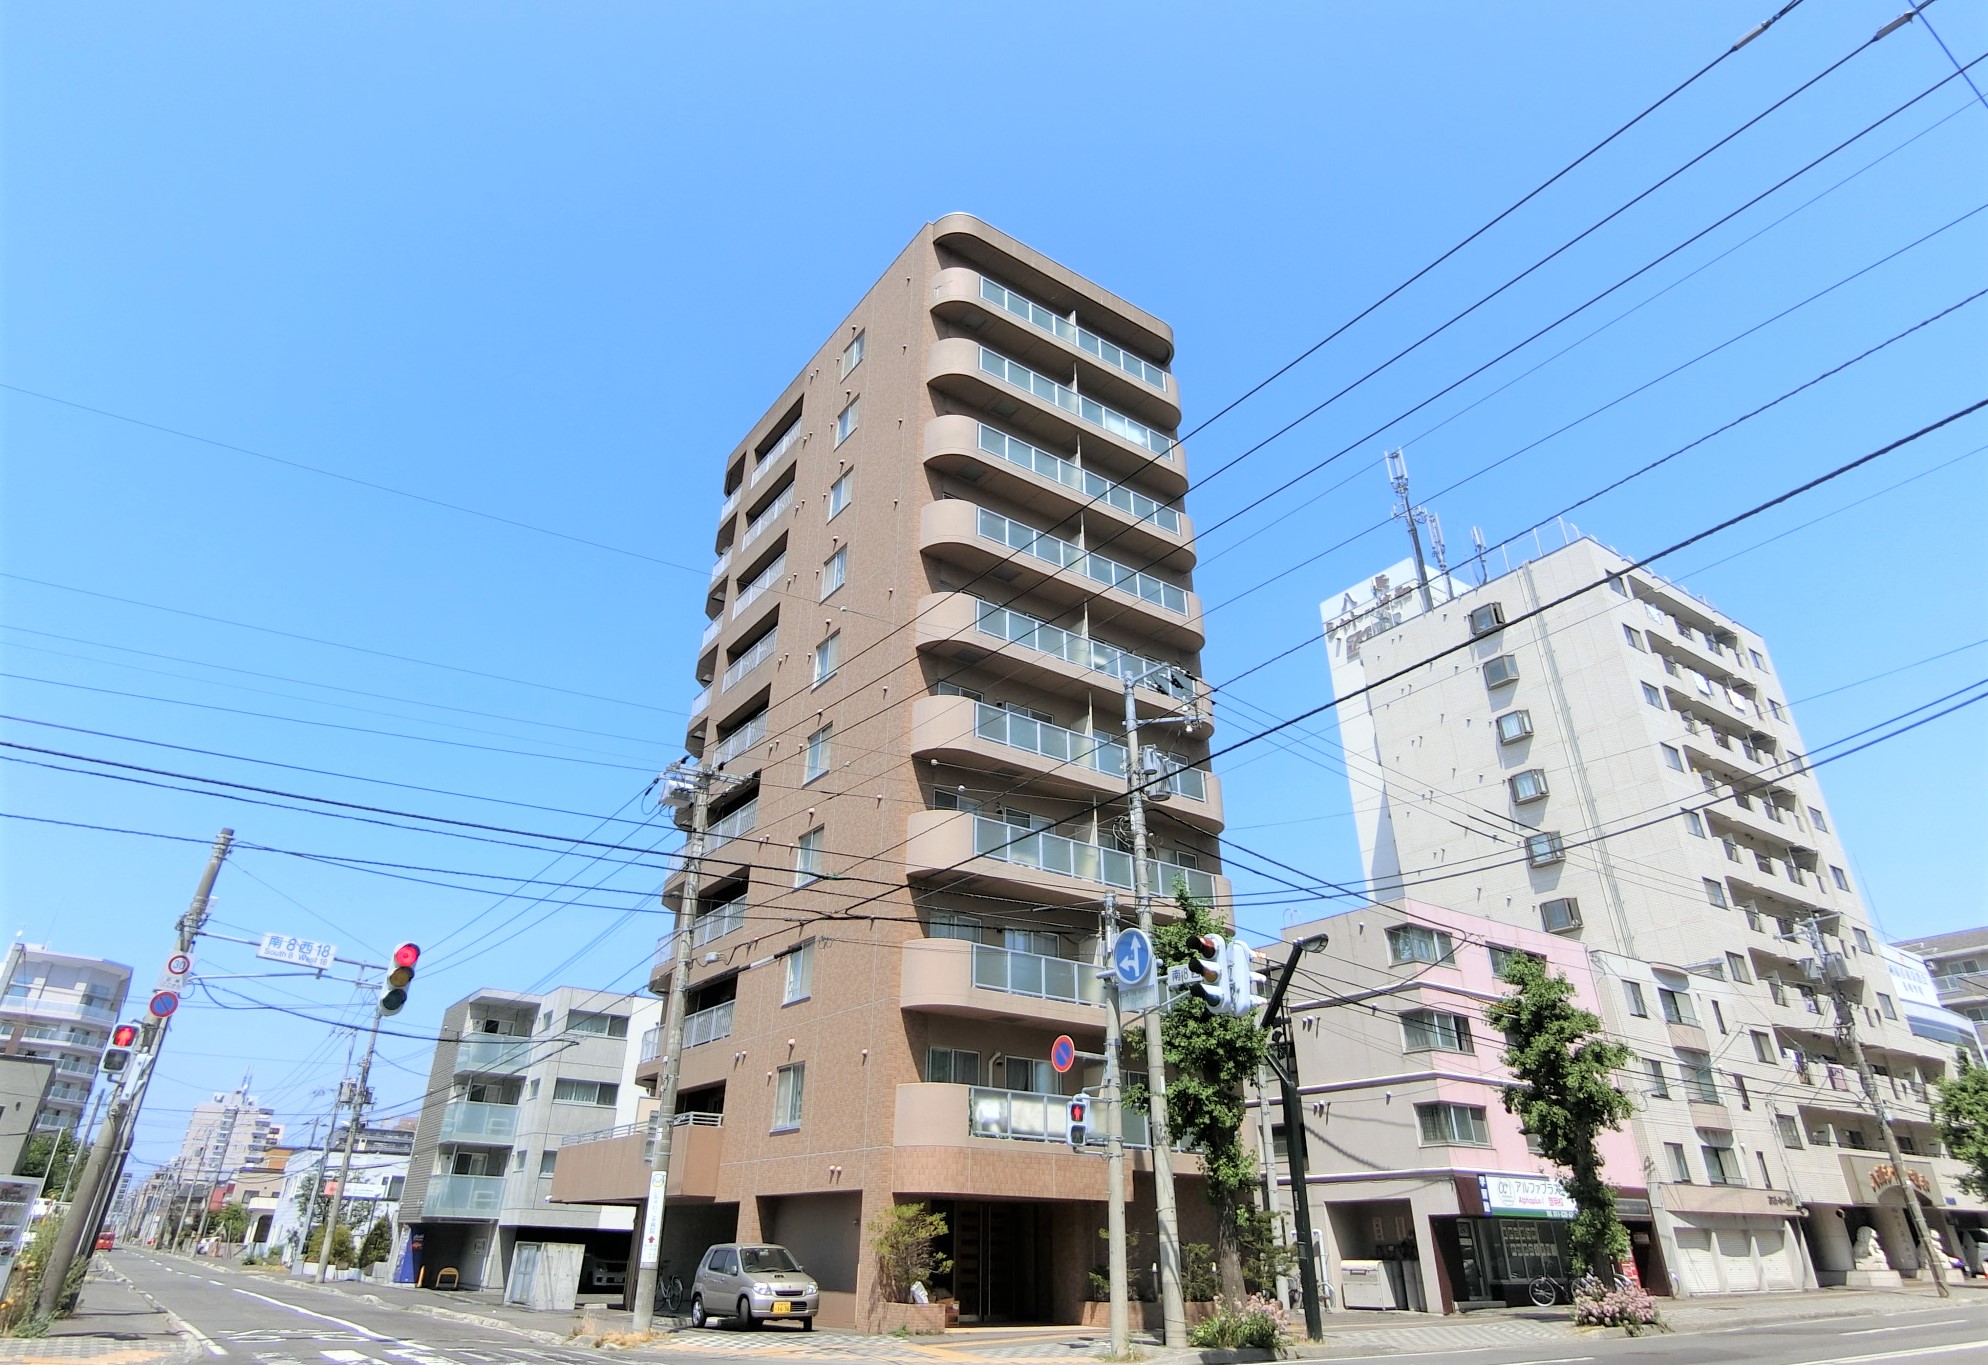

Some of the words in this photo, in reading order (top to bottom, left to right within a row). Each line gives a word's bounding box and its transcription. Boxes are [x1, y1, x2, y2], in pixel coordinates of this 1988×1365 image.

[264, 947, 287, 959] South
[298, 954, 318, 965] West
[173, 960, 186, 970] 30
